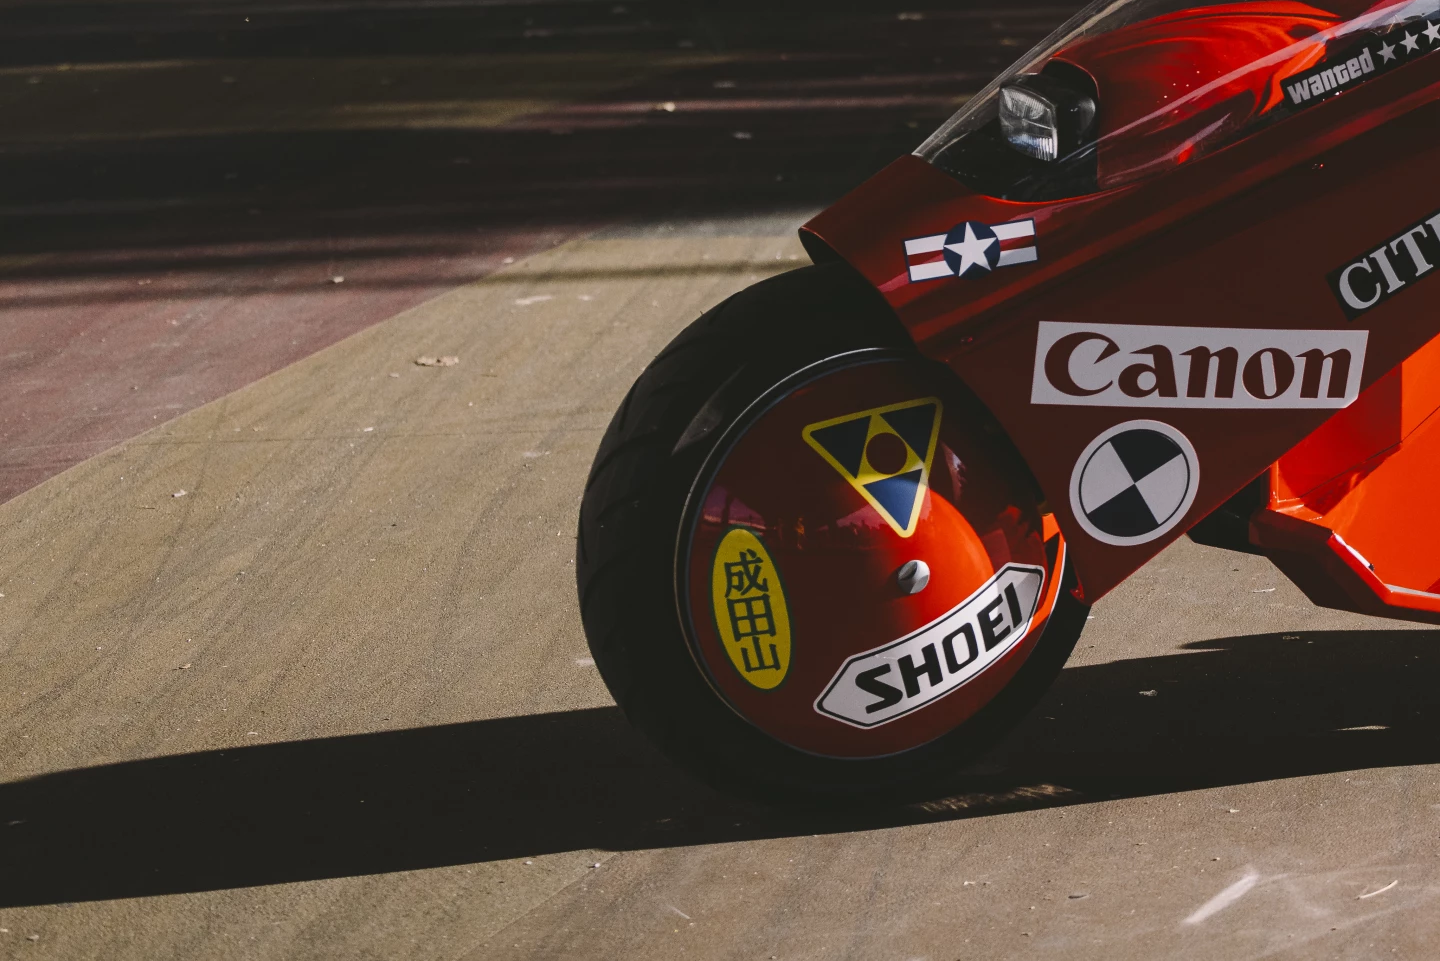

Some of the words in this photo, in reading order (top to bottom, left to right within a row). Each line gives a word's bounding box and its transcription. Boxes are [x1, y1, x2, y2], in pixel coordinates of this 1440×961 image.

[1044, 331, 1350, 401] Canon
[723, 549, 781, 674] 成田山
[854, 581, 1023, 715] SHOEI
